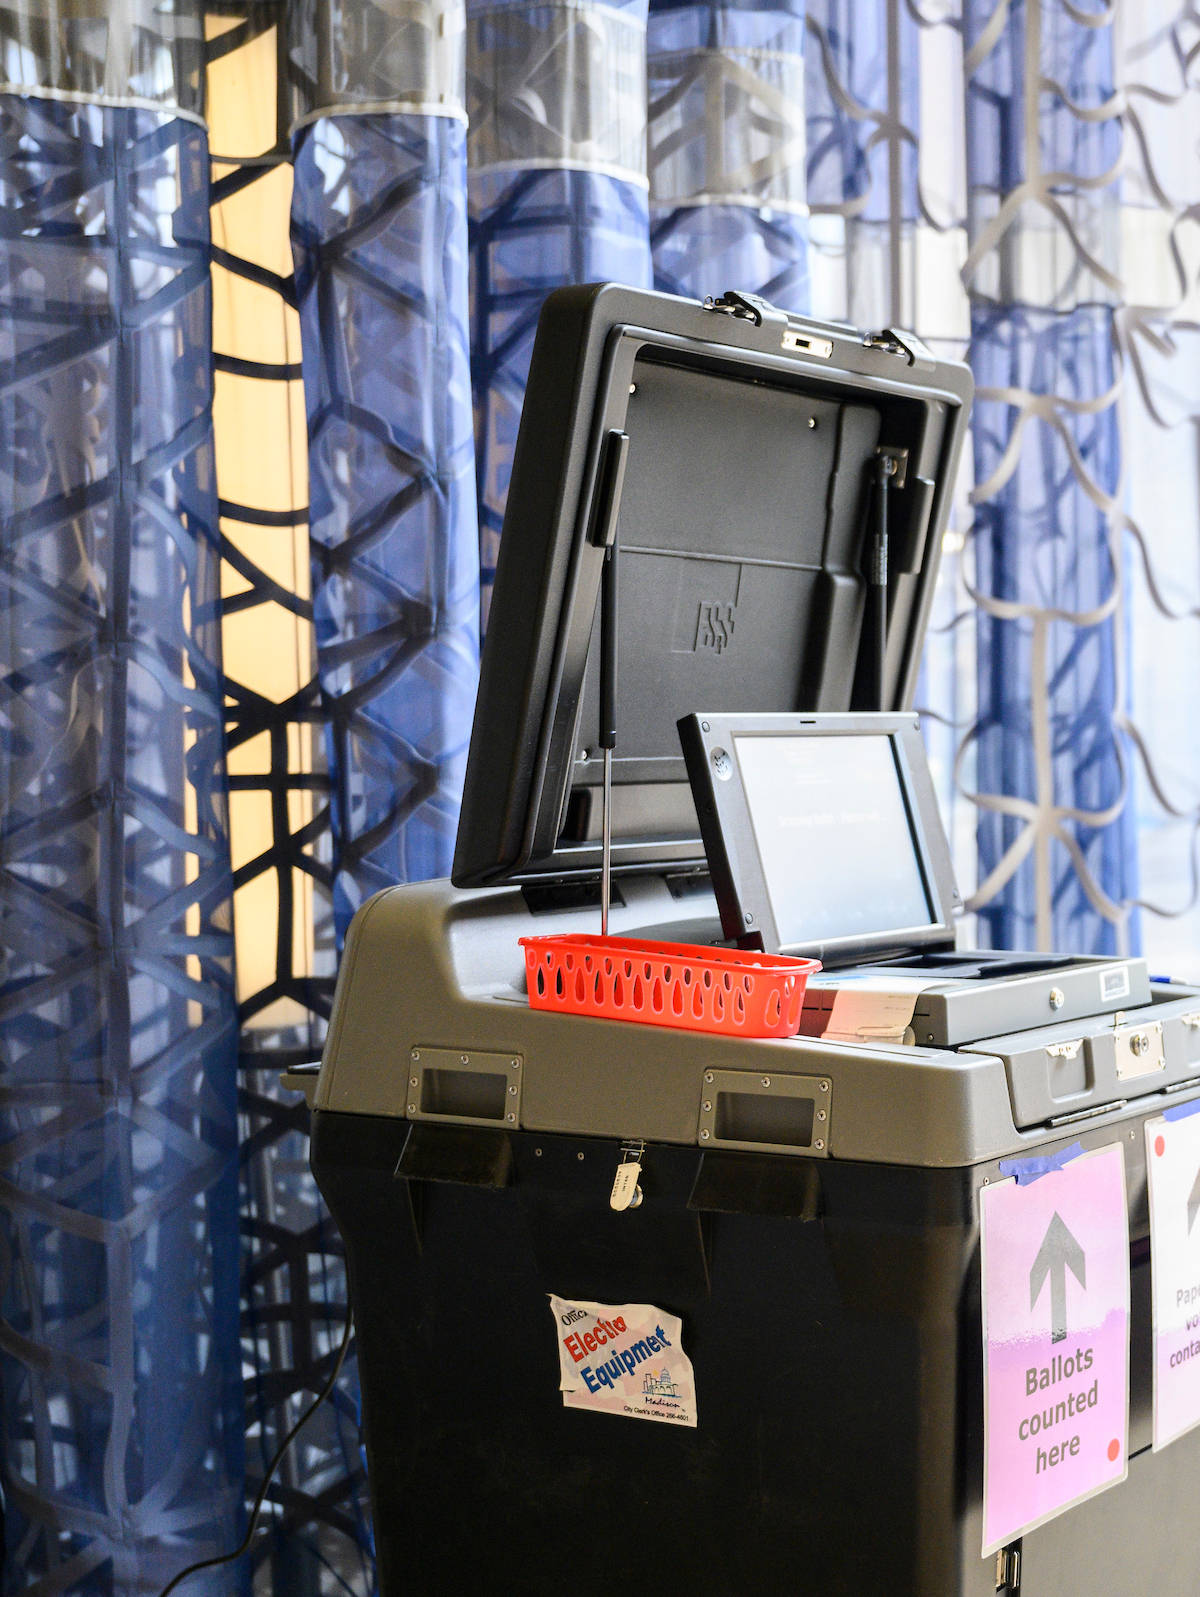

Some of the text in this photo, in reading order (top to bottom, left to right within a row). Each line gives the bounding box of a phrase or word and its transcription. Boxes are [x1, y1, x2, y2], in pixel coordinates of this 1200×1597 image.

[1026, 1347, 1093, 1396] Ballots
[645, 1396, 681, 1408] Madison
[651, 1409, 665, 1418] Office
[1018, 1379, 1098, 1441] counted
[1036, 1435, 1080, 1474] here
